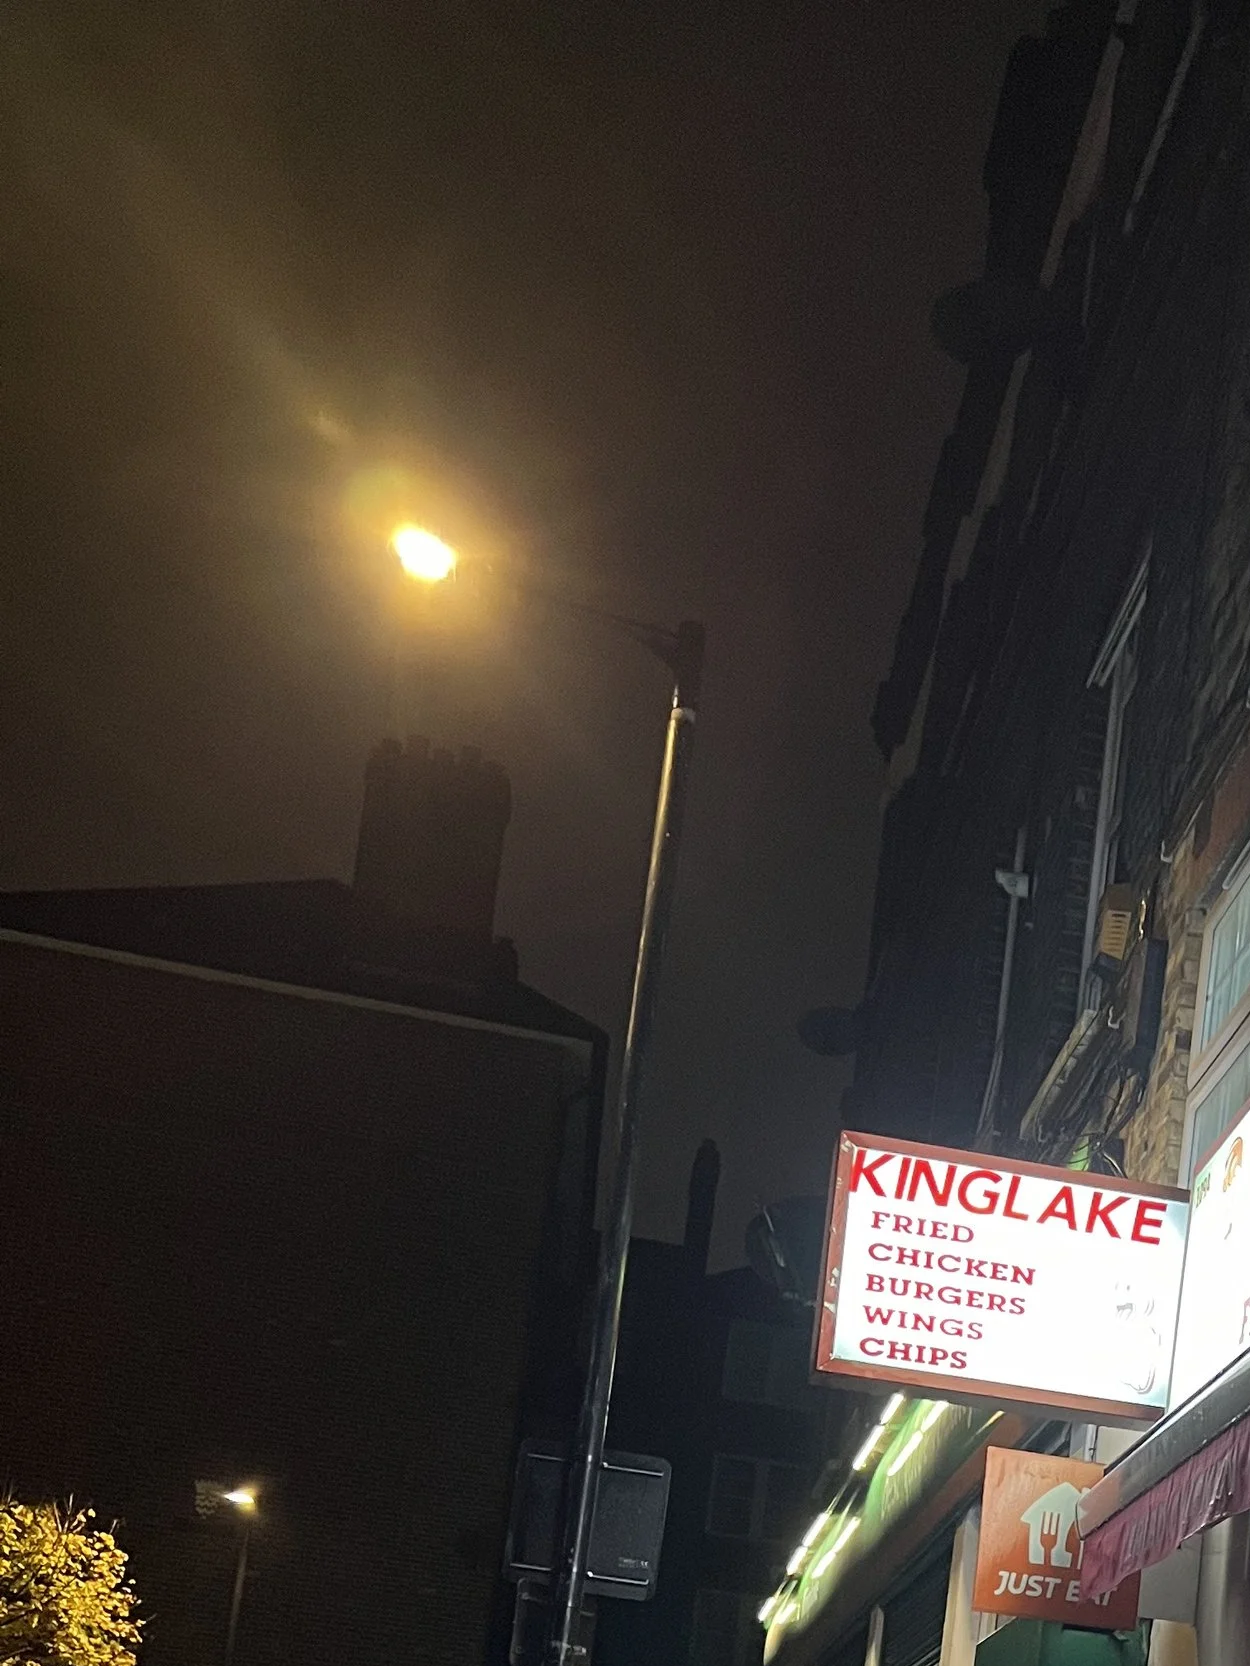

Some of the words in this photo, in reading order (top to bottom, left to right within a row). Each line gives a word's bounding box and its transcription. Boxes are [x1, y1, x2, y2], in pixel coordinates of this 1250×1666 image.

[848, 1147, 1168, 1246] KINGLAKE
[870, 1210, 975, 1244] FRIED
[867, 1242, 1036, 1286] CHICKEN
[865, 1274, 1026, 1315] BURGERS
[862, 1304, 984, 1340] WINGS
[859, 1336, 968, 1370] CHIPS
[994, 1570, 1061, 1599] JUST
